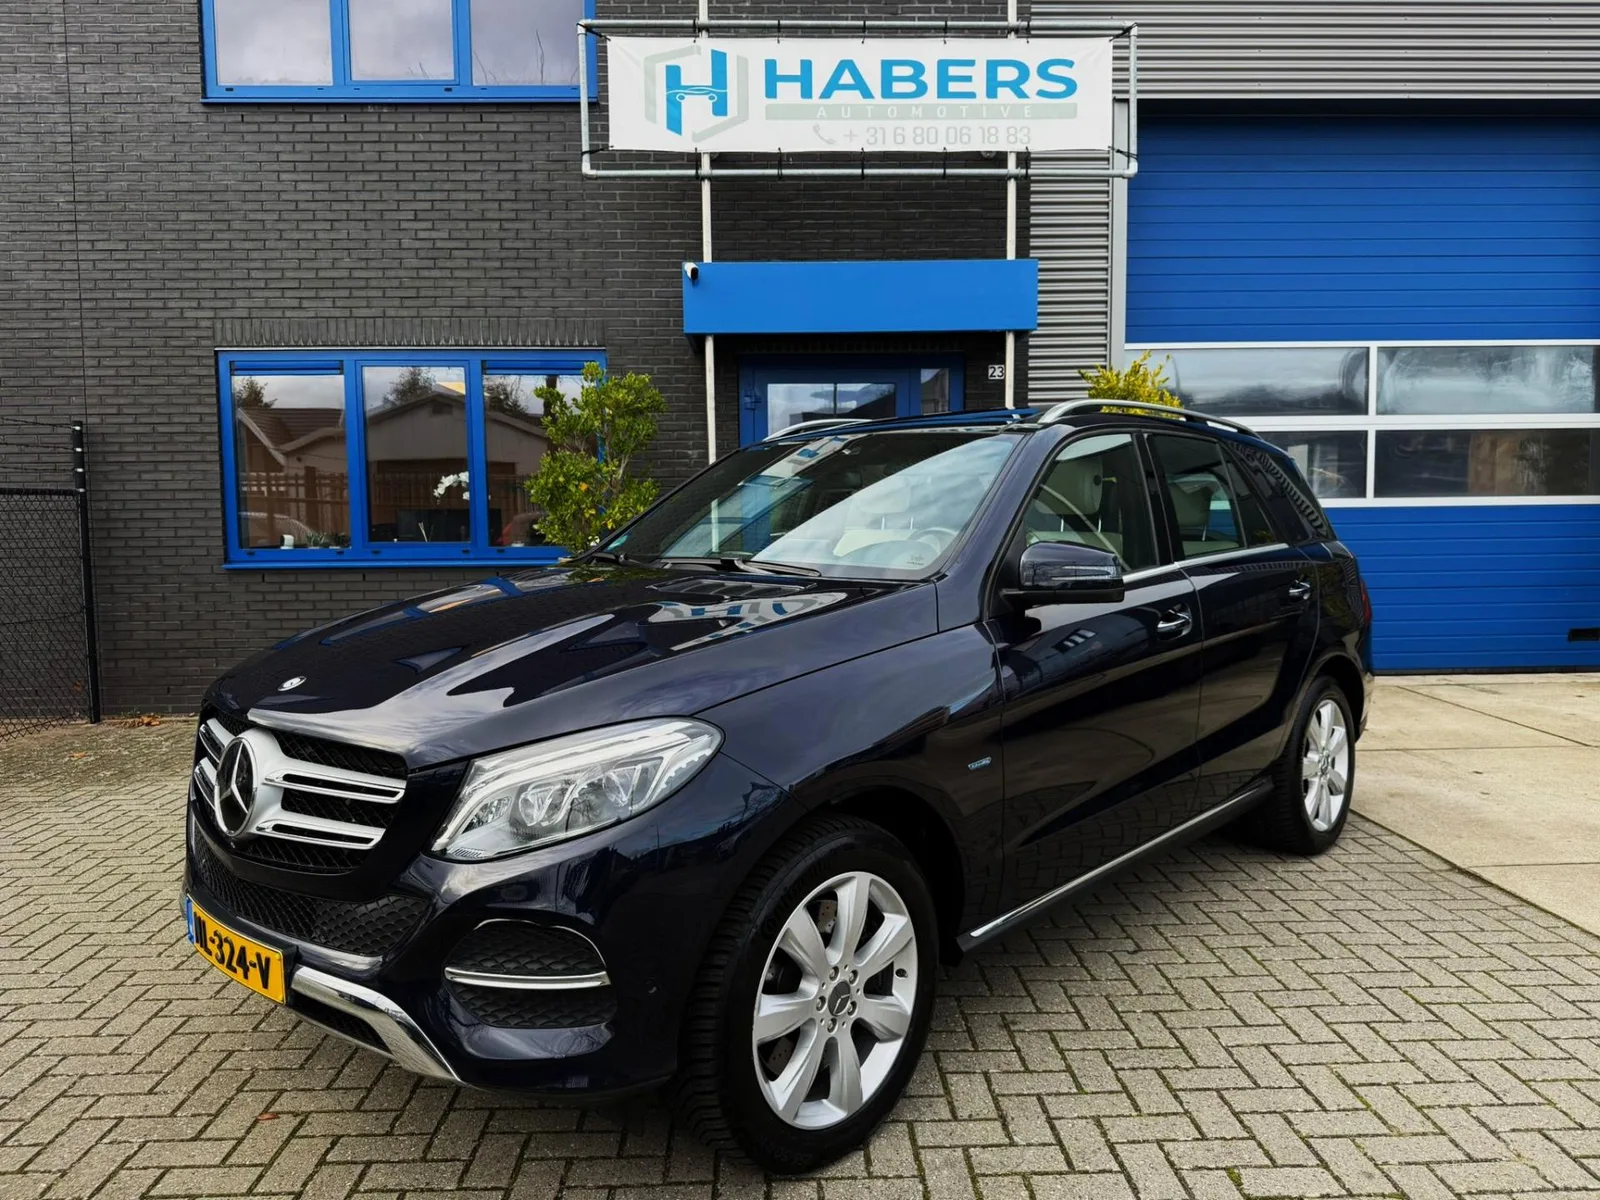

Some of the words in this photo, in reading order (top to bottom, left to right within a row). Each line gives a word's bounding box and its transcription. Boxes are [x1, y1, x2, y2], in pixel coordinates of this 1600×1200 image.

[764, 58, 1078, 99] HABERS
[816, 105, 1032, 118] AUTOMOTIVE
[865, 126, 886, 145] 31
[893, 126, 905, 145] 6
[912, 126, 938, 145] 80
[945, 126, 971, 145] 06
[978, 126, 999, 145] 18
[1006, 126, 1031, 145] 83
[989, 366, 1004, 378] 23
